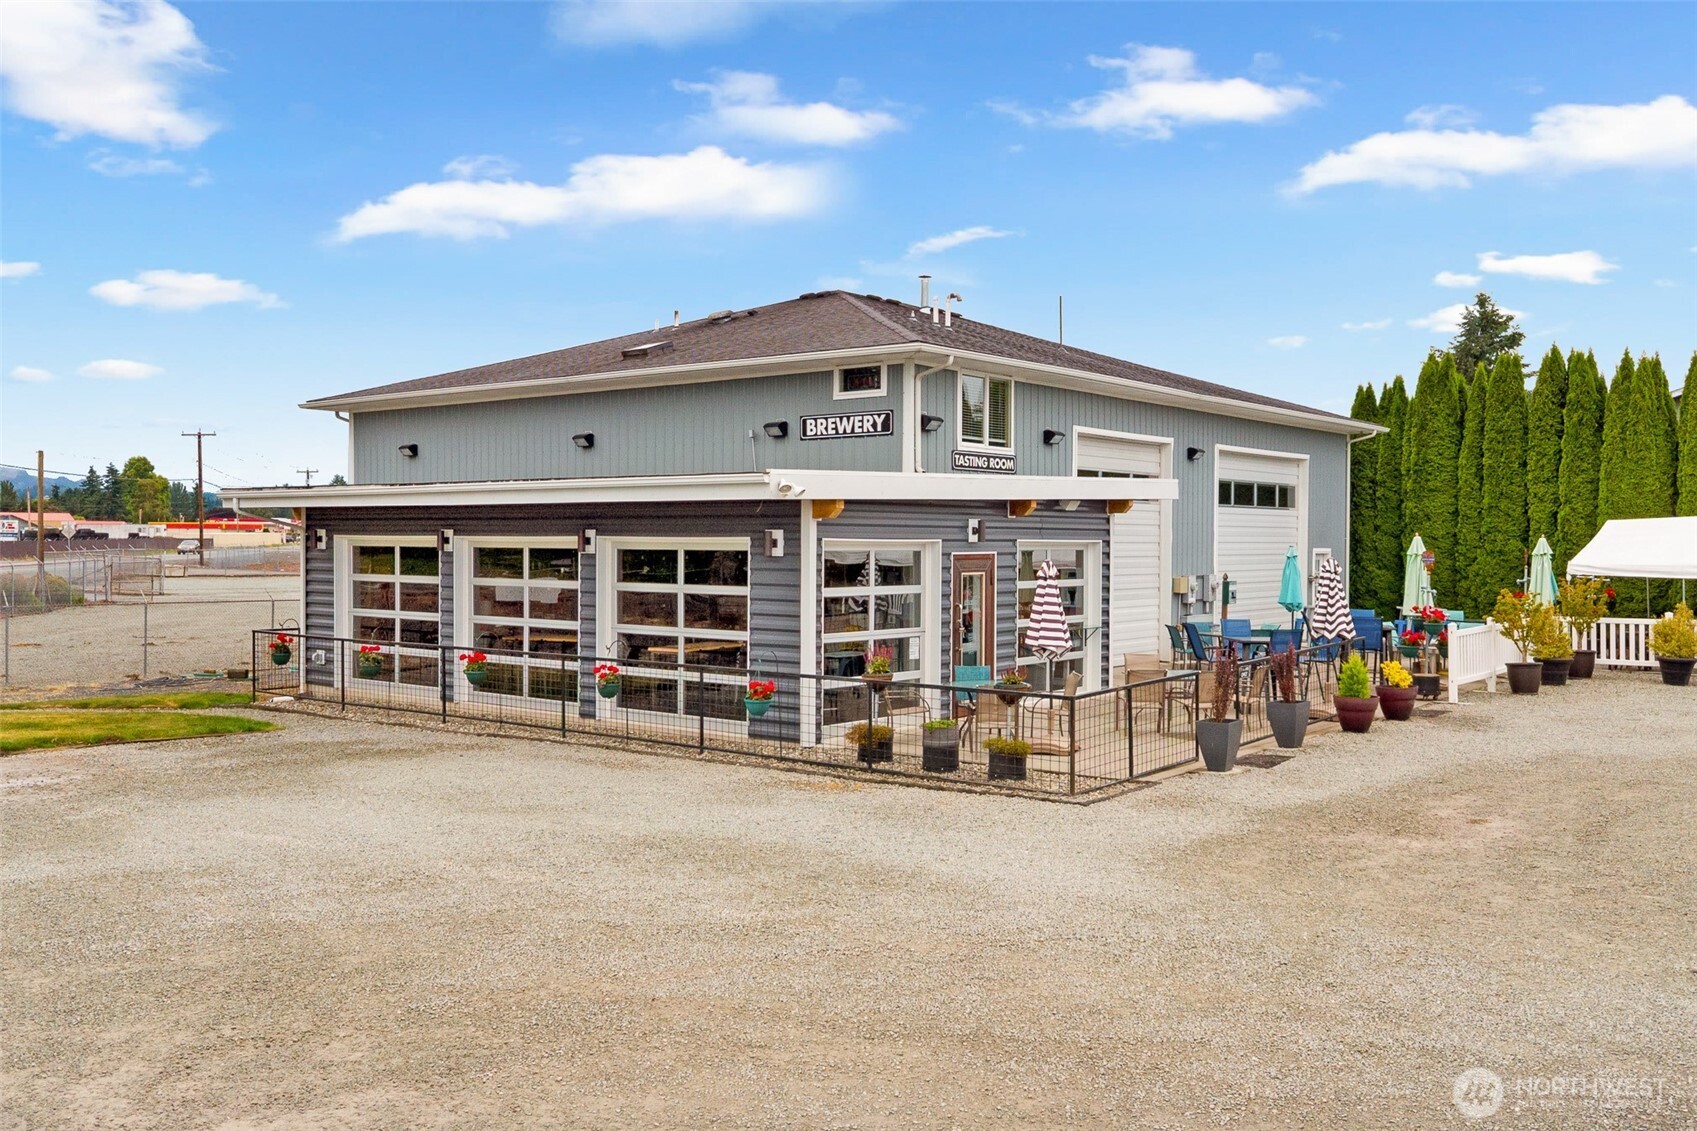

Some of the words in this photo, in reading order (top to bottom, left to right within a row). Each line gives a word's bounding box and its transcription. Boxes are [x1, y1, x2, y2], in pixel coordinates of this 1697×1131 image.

[806, 414, 886, 436] BREWERY
[954, 454, 988, 468] TASTING
[989, 457, 1015, 470] ROOM
